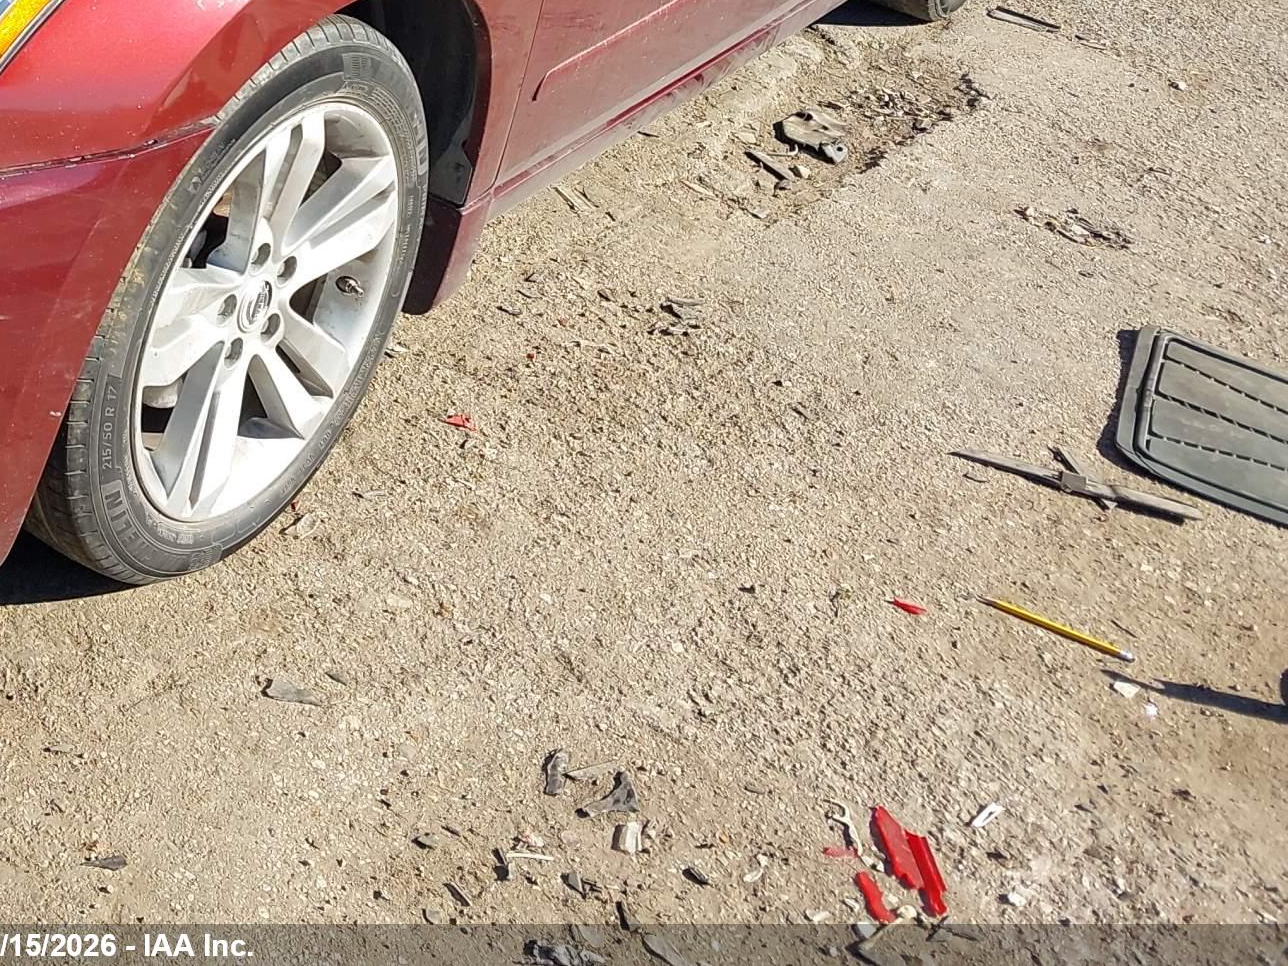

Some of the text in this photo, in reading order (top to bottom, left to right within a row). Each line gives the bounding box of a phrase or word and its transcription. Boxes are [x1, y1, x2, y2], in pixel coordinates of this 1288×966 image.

[107, 385, 118, 400] 17
[104, 406, 115, 418] R
[102, 423, 113, 470] 215/50
